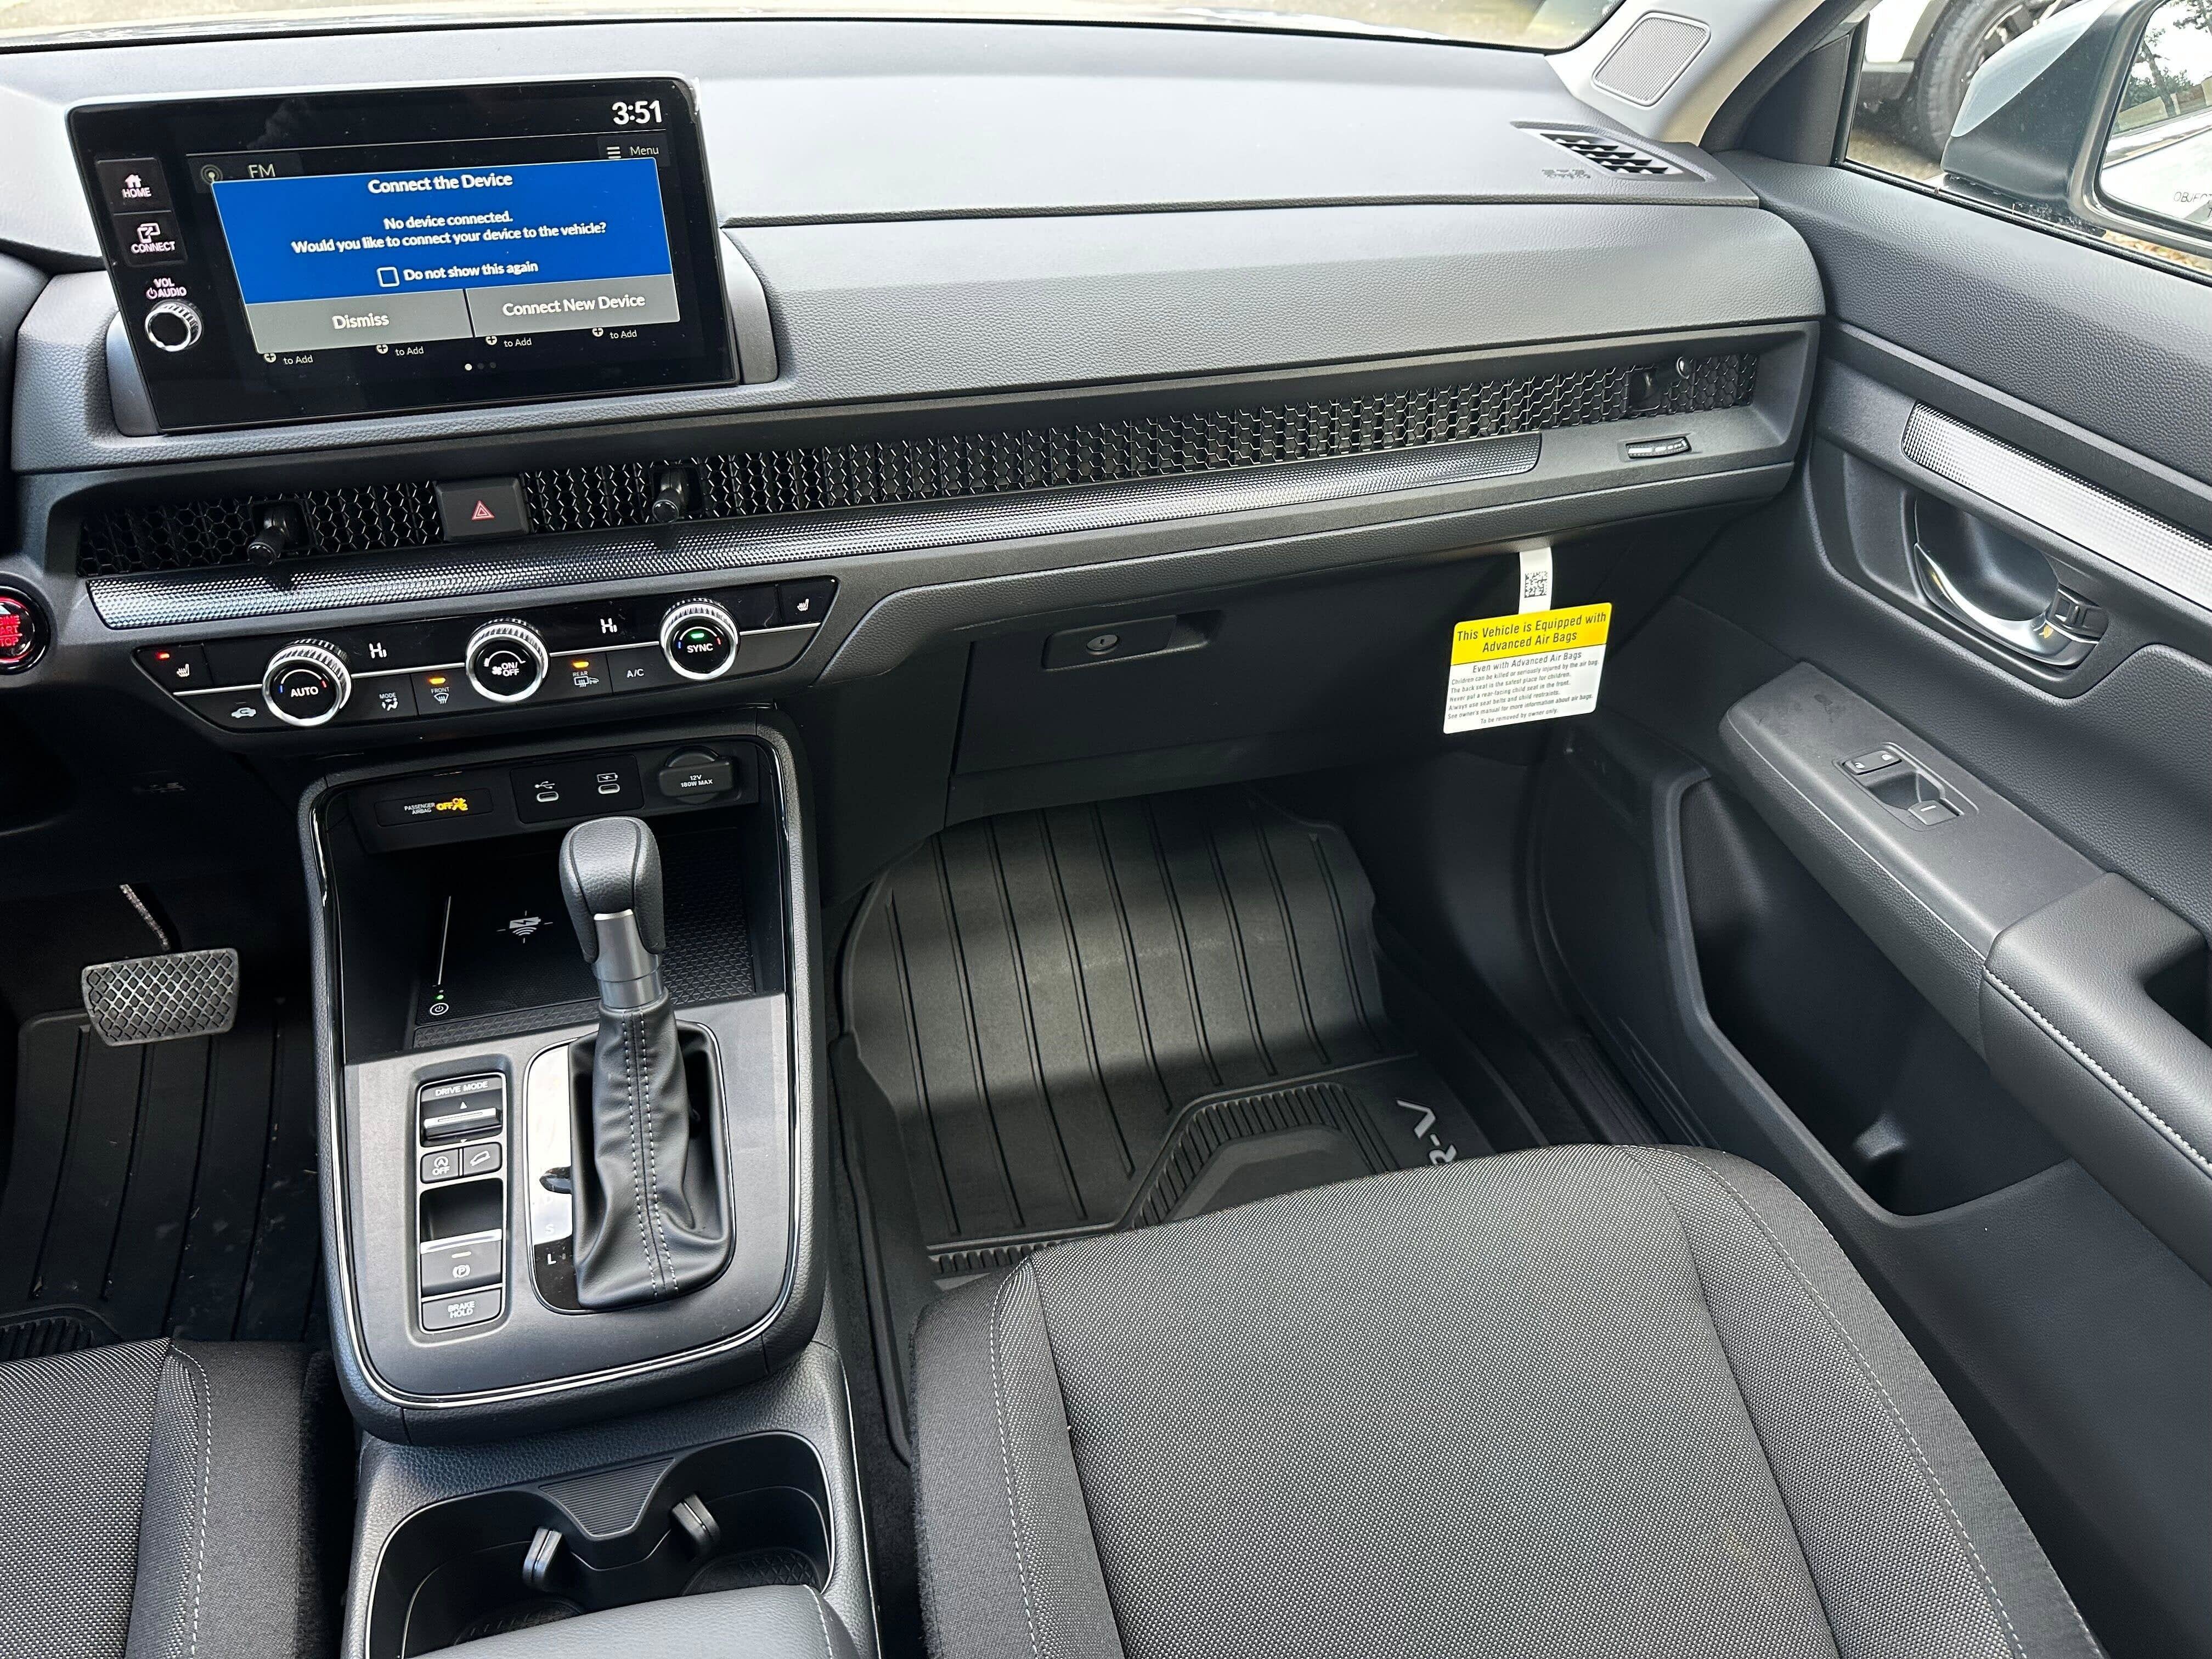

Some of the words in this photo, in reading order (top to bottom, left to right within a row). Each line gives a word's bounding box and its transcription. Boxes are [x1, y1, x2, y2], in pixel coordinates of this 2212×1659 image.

[612, 100, 662, 125] 3:51
[630, 145, 659, 156] Menu
[249, 164, 275, 178] FM
[368, 177, 432, 193] Connect
[435, 175, 459, 189] the
[462, 173, 512, 188] Device
[122, 187, 151, 199] HOME
[384, 217, 404, 229] No
[405, 215, 445, 229] device
[447, 210, 513, 225] connected.
[291, 240, 335, 253] Would
[336, 239, 360, 252] you
[362, 236, 383, 249] like
[386, 236, 399, 247] to
[402, 233, 450, 246] connect
[453, 230, 481, 245] your
[483, 228, 521, 241] device
[523, 227, 537, 238] to
[539, 225, 558, 237] the
[561, 222, 606, 236] vehicle?
[131, 240, 176, 253] CONNECT
[404, 269, 422, 281] Do
[425, 267, 445, 278] not
[448, 265, 480, 277] show
[482, 263, 504, 275] this
[505, 262, 538, 274] again
[153, 278, 175, 288] VOL
[158, 286, 187, 297] AUDIO
[503, 301, 561, 316] Connect
[563, 298, 595, 312] New
[599, 294, 645, 309] Device
[332, 314, 389, 329] Dismiss
[610, 331, 619, 339] to
[621, 330, 637, 338] Add
[516, 338, 532, 346] Add
[408, 347, 424, 355] Add
[284, 356, 294, 364] to
[296, 355, 313, 364] Add
[0, 625, 19, 634] ART
[1457, 630, 1478, 641] This
[1482, 624, 1519, 637] Vehicle
[1523, 622, 1532, 632] is
[1536, 615, 1582, 631] Equipped
[1585, 612, 1606, 624] with
[0, 636, 20, 646] TOP
[1482, 637, 1531, 652] Advanced
[1535, 635, 1550, 645] Air
[1553, 631, 1577, 644] Bags
[687, 642, 713, 653] SYNC
[501, 662, 518, 670] ON/
[1472, 665, 1491, 673] Even
[1493, 661, 1509, 670] with
[1511, 656, 1548, 667] Advanced
[503, 667, 520, 676] OFF
[627, 669, 644, 678] A/C
[291, 686, 319, 698] AUTO
[1482, 689, 1510, 697] rear-facing
[1496, 713, 1519, 721] removed
[404, 803, 435, 811] PASSENGER
[436, 1085, 461, 1096] DRIVE
[463, 1081, 488, 1092] MODE
[1396, 1098, 1457, 1165] R-V
[432, 1166, 450, 1175] OFF
[545, 1224, 554, 1233] S
[548, 1254, 557, 1265] L
[448, 1301, 475, 1313] BRAKE
[450, 1308, 473, 1318] HOLD
